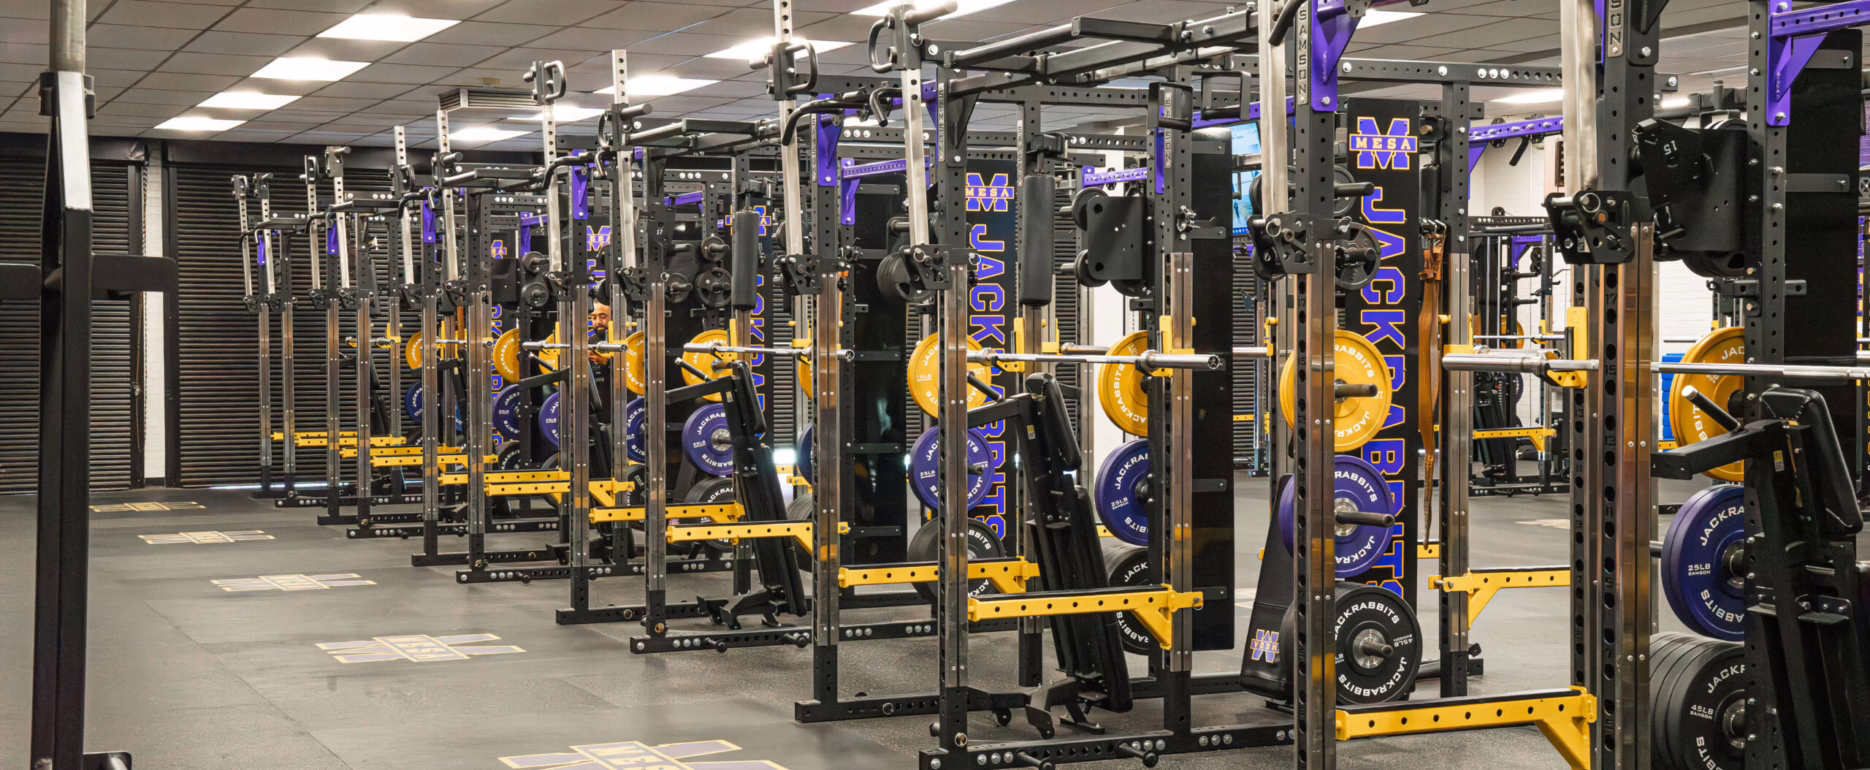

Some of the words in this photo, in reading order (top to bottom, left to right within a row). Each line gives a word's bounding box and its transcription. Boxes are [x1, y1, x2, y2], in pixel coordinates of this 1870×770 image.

[1610, 0, 1622, 46] SON
[1298, 9, 1307, 95] SAMSON
[1356, 137, 1411, 150] MESA
[965, 187, 1009, 197] MESA
[1605, 294, 1617, 304] 17
[1334, 344, 1376, 379] RABBITS
[1604, 365, 1616, 375] 15
[1113, 363, 1148, 424] ACKRABBITS
[696, 412, 726, 436] JACKRAB
[701, 453, 733, 468] RABBITS
[1114, 453, 1148, 490] JACKRA
[1334, 471, 1378, 503] RABBITS
[1700, 505, 1745, 547] JACKRA
[1334, 539, 1376, 565] JACKRA
[1687, 563, 1711, 571] 25LB
[1700, 589, 1745, 623] ABBITS
[1116, 610, 1149, 644] RABBITS
[1338, 656, 1407, 697] JACKRABBITS
[1690, 704, 1714, 715] 45LB
